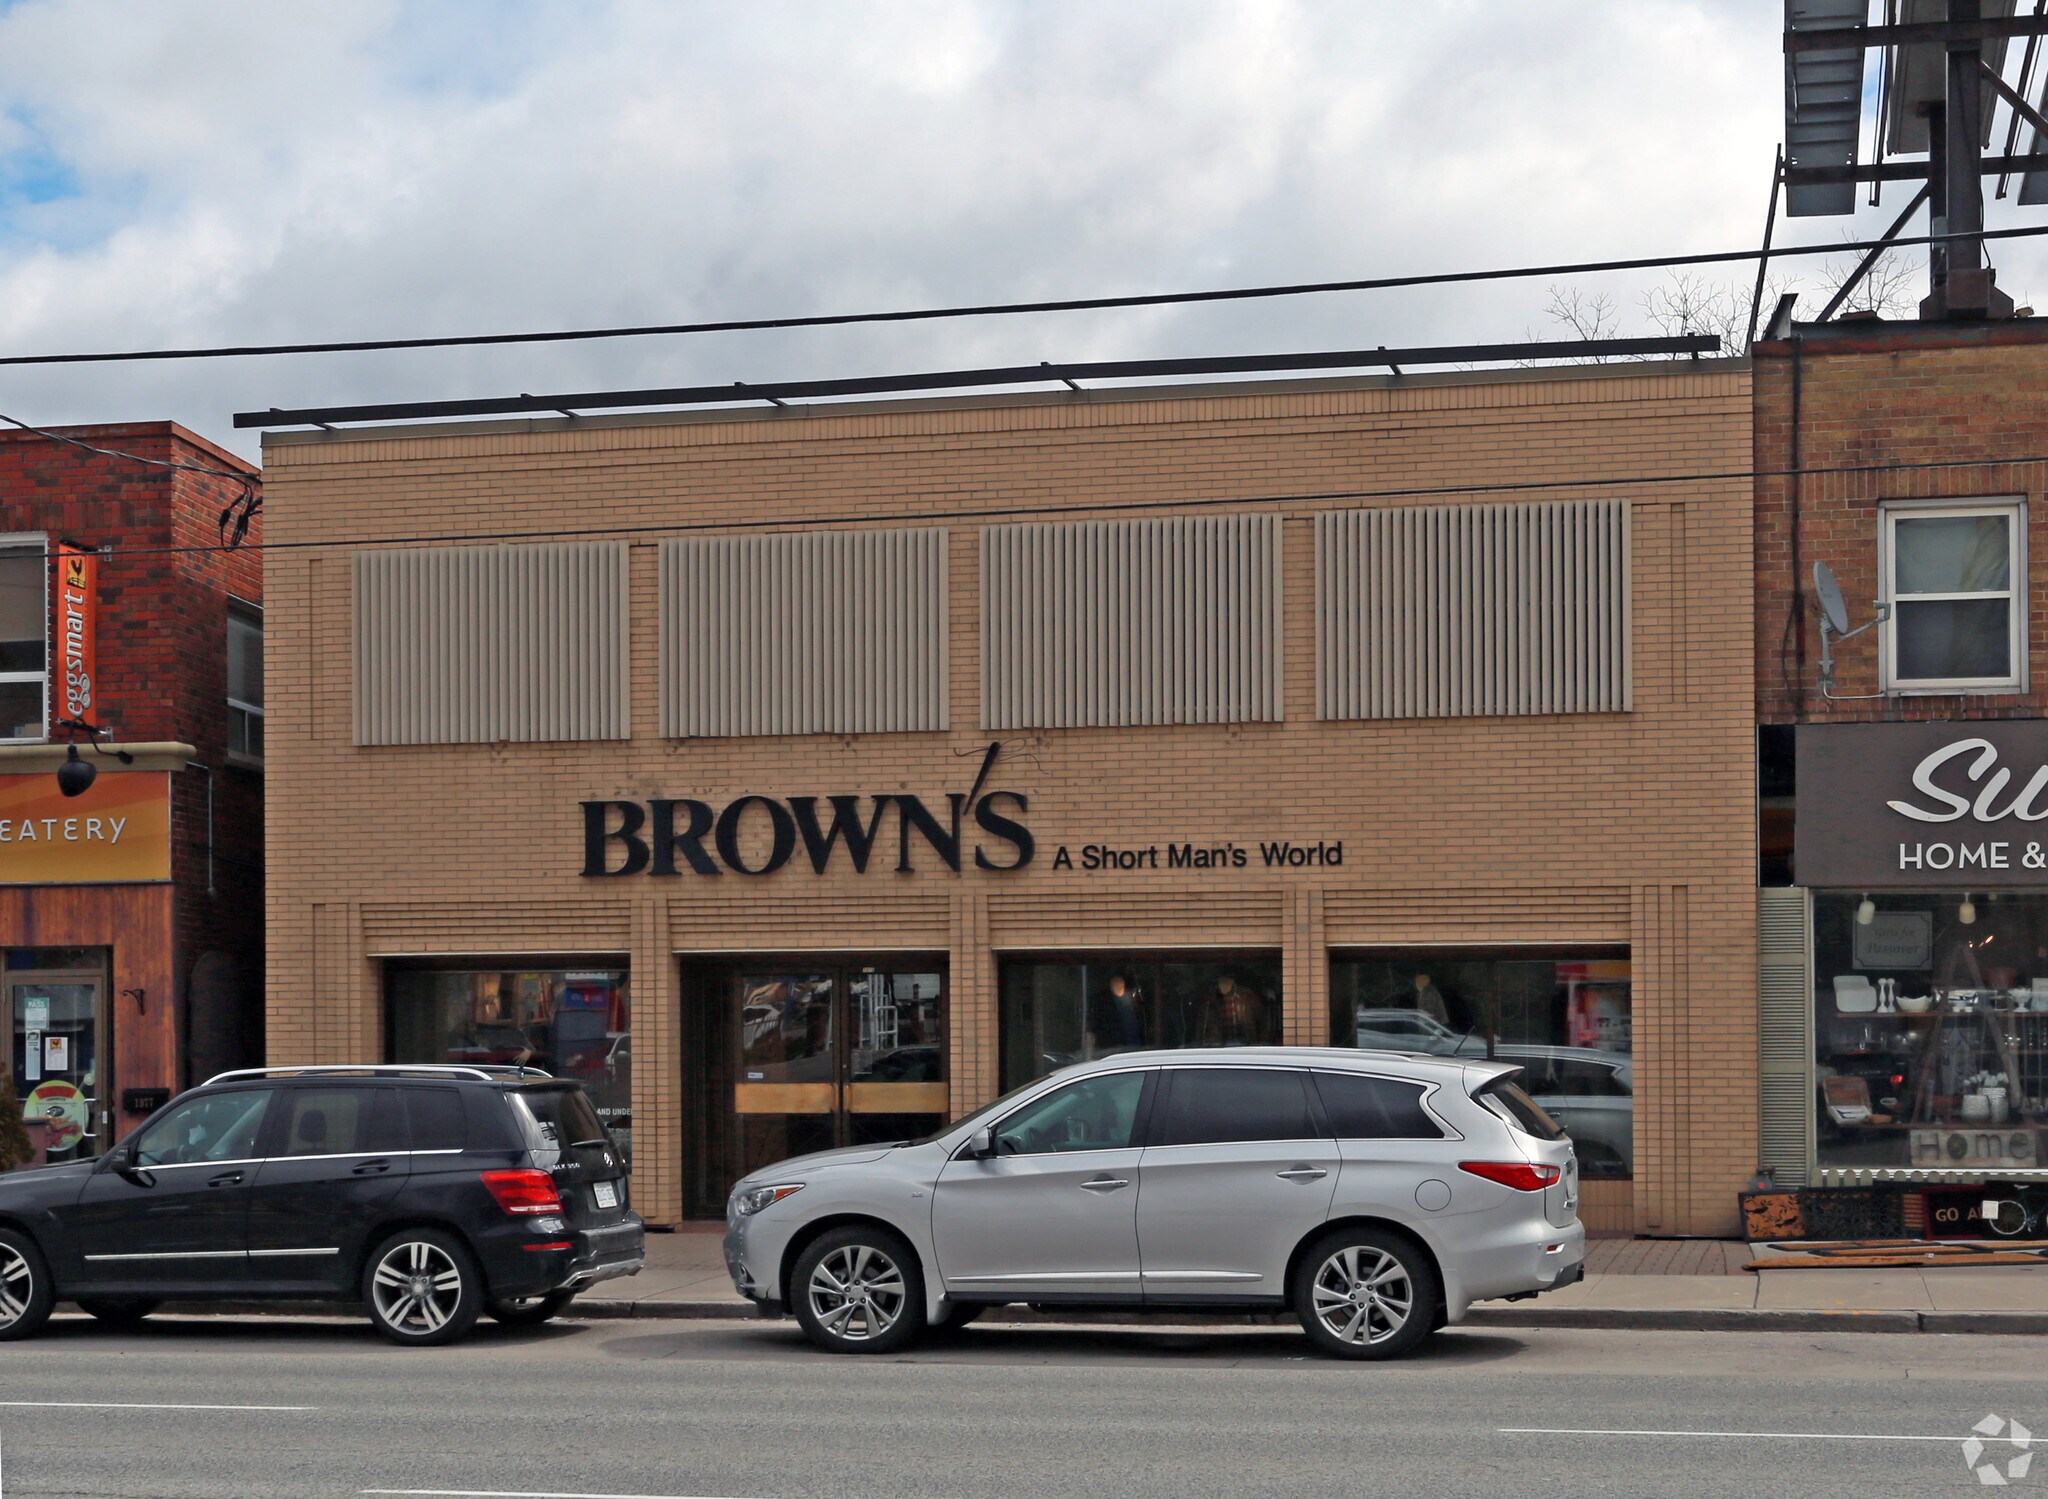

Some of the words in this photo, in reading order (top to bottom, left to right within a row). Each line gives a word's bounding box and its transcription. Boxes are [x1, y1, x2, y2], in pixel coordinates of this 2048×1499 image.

[65, 588, 91, 717] eggsmart
[578, 741, 1036, 877] BROWN'S
[0, 817, 126, 844] EATERY
[1052, 846, 1073, 871] A
[1081, 844, 1158, 870] Short
[1167, 842, 1248, 869] Man's
[1259, 841, 1343, 868] World
[1899, 841, 2010, 870] HOME
[2021, 841, 2047, 869] &
[27, 1000, 45, 1008] PASS
[612, 1107, 632, 1116] UNDE
[1918, 1131, 2030, 1160] Home
[1935, 1207, 1959, 1222] GO
